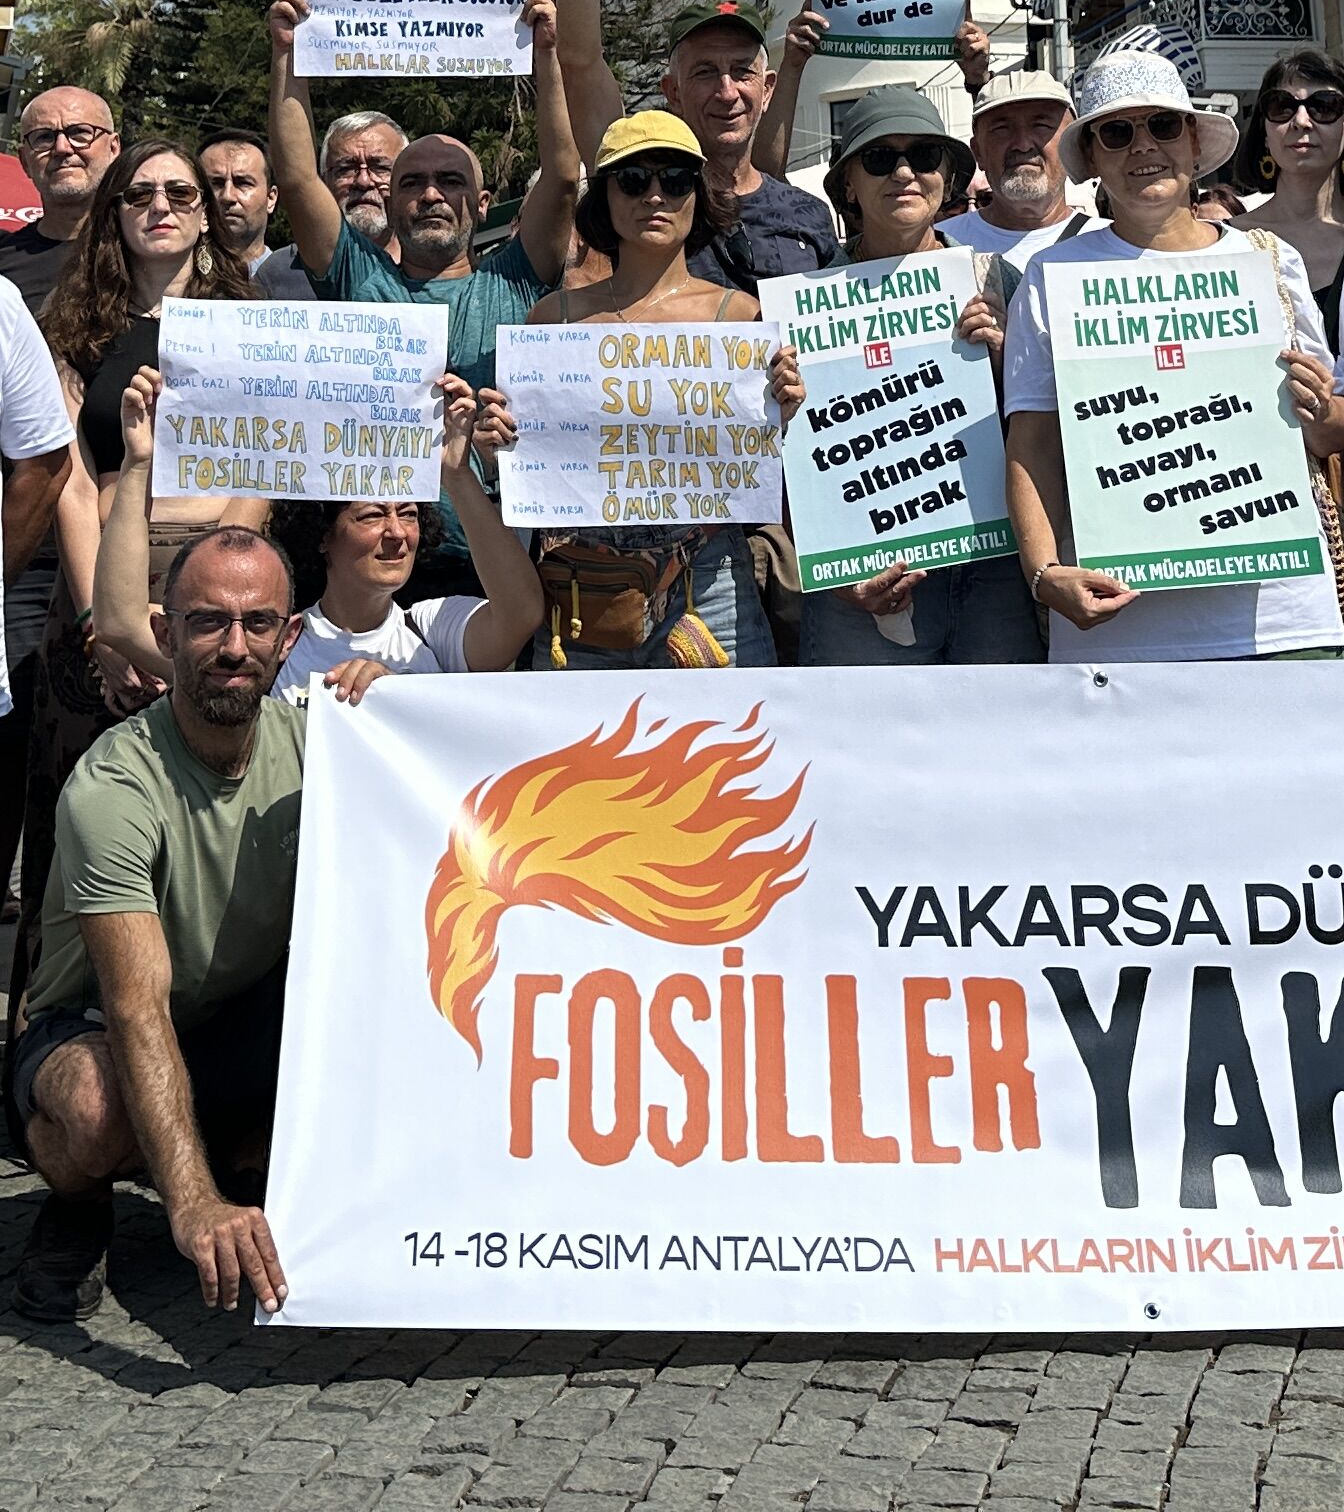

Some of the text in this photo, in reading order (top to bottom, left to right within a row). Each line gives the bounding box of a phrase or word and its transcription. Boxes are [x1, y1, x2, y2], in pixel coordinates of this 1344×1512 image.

[335, 20, 484, 37] KİMSE YAZMIYOR
[857, 2, 933, 27] dur de
[335, 53, 514, 74] HALKLAR SUSMUYOR
[795, 267, 942, 316] HALKLARIN
[1082, 270, 1240, 306] HALKLARIN
[237, 306, 402, 335] YERİN ALTINDA
[788, 295, 960, 354] İKLİM ZİRVESİ
[1074, 300, 1259, 346] İKLİM ZİRVESİ
[238, 340, 393, 366] YERİN ALTINDA
[375, 336, 427, 355] BIRAK
[598, 332, 771, 371] ORMAN YOK
[238, 374, 395, 403] YERİN ALTINDA
[372, 366, 422, 383] BIRAK
[371, 405, 422, 423] BIRAK
[601, 377, 652, 417] SU
[667, 378, 735, 419] YOK
[806, 360, 944, 433] kömürü
[1074, 385, 1160, 421] suyu,
[165, 413, 433, 459] YAKARSA DÜNYAYI
[600, 420, 781, 458] ZEYTİN YOK
[812, 397, 968, 471] toprağın
[1116, 393, 1253, 445] toprağı,
[178, 453, 414, 496] FOSİLLER YAKAR
[598, 459, 760, 489] TARIM YOK
[842, 438, 969, 504] altında
[1096, 442, 1217, 489] havayı,
[602, 490, 733, 523] ÖMÜR YOK
[868, 479, 967, 535] bırak
[1143, 463, 1264, 512] ormanı
[1200, 489, 1299, 534] savun
[855, 883, 1231, 948] YAKARSA
[508, 947, 1042, 1167] FOSİLLER
[404, 1232, 445, 1268] 14
[518, 1233, 649, 1270] KASIM
[659, 1235, 915, 1274] ANTALYA'DA
[934, 1235, 1177, 1274] HALKLARIN
[1183, 1226, 1293, 1273] İKLİM
